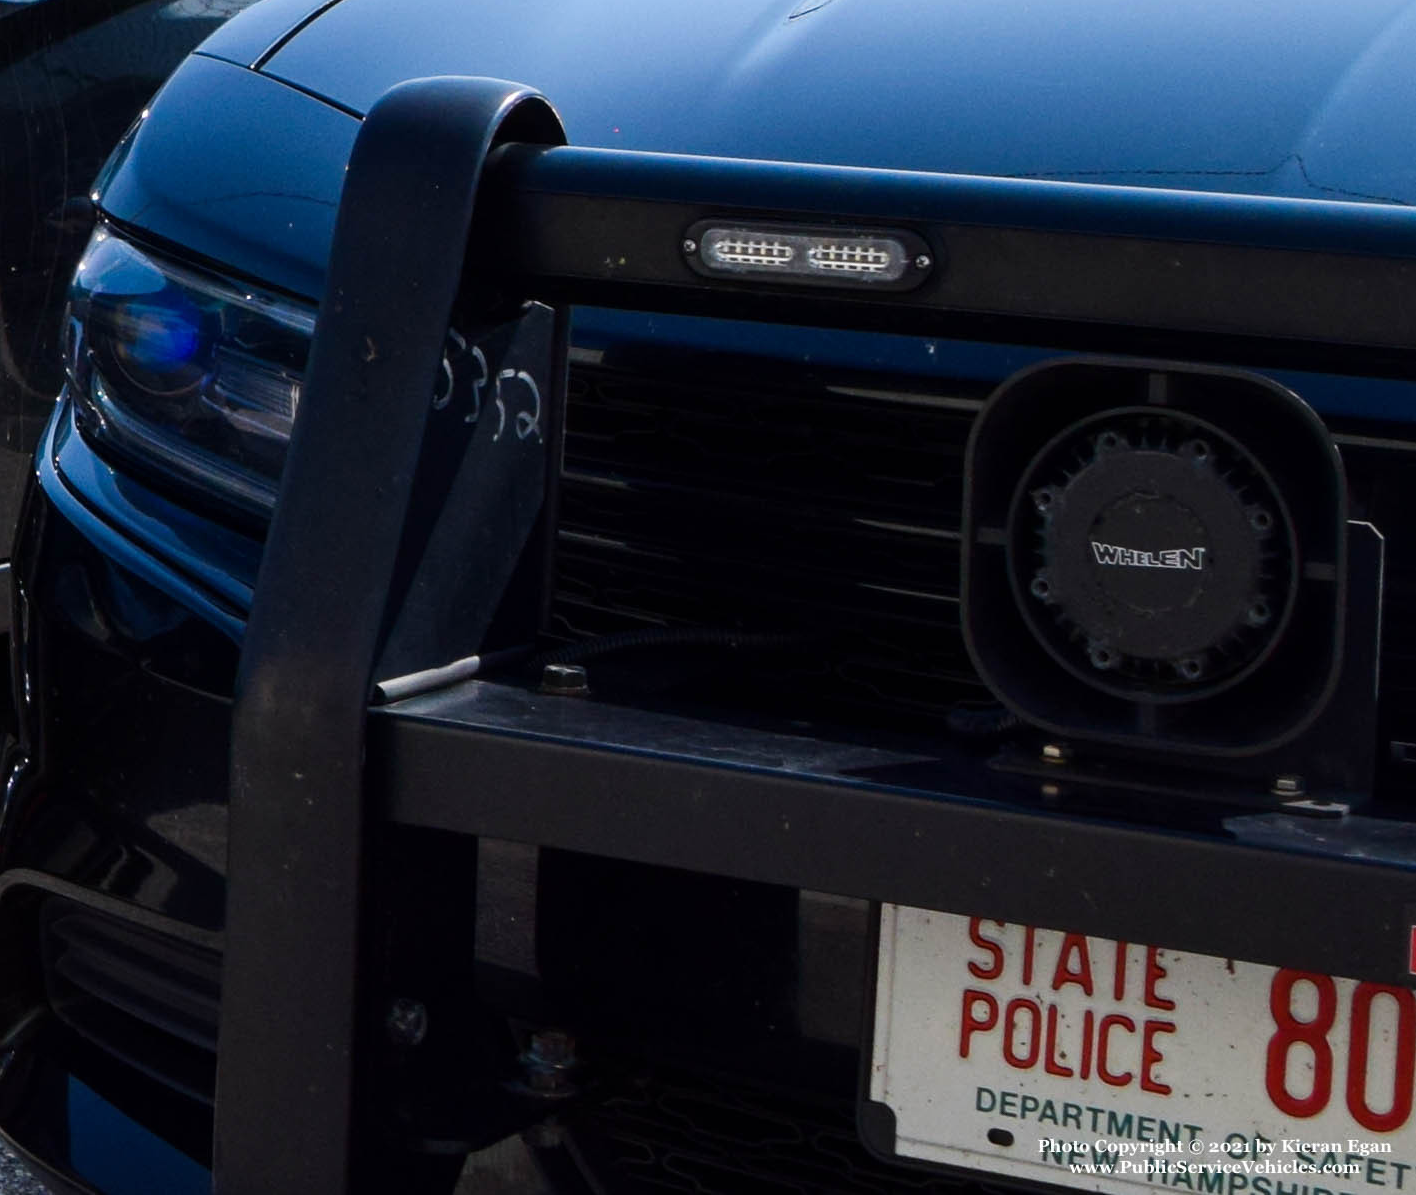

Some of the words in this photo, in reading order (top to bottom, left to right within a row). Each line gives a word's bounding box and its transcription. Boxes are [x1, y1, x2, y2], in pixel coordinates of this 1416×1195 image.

[1091, 541, 1206, 570] WHELEN
[958, 989, 1177, 1096] POLICE
[1265, 967, 1416, 1133] 80
[975, 1086, 1203, 1149] DEPARTMENT
[1296, 1147, 1416, 1191] SAFET
[1041, 1137, 1119, 1175] NEW
